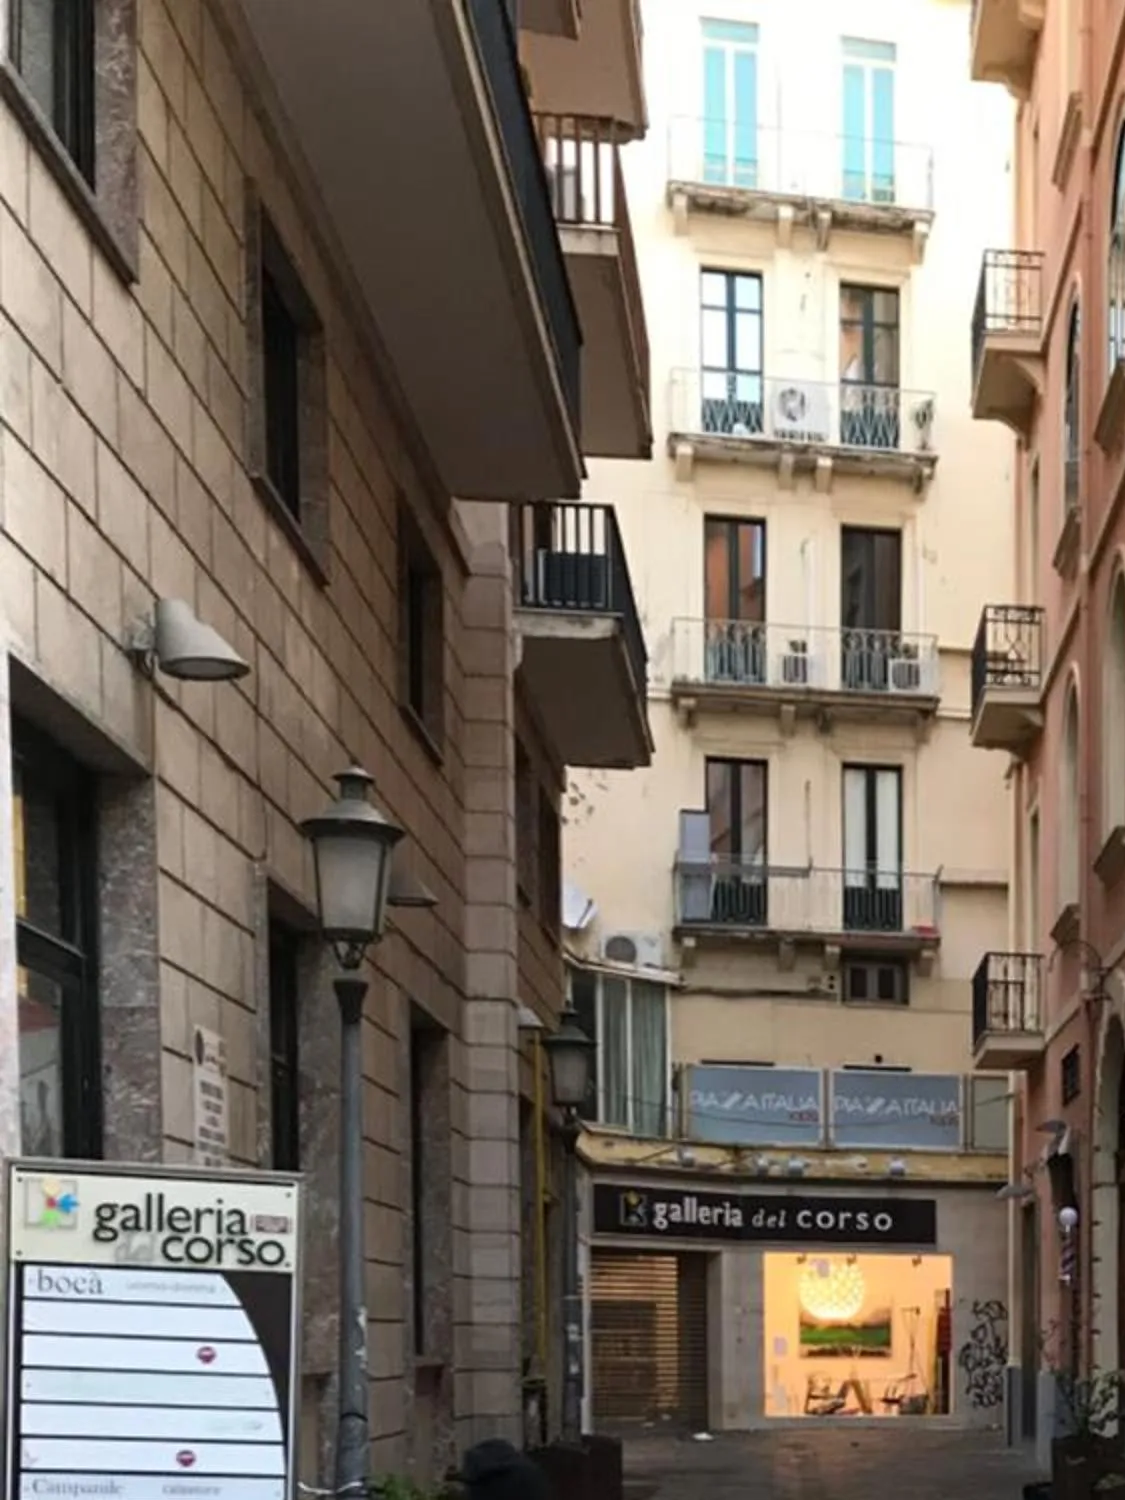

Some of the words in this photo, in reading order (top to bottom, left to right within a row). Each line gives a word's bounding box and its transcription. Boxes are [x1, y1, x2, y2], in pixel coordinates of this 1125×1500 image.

[92, 1192, 248, 1243] galleria
[652, 1196, 744, 1229] galleria
[752, 1208, 787, 1229] del
[796, 1208, 893, 1232] corso
[161, 1234, 286, 1267] corso
